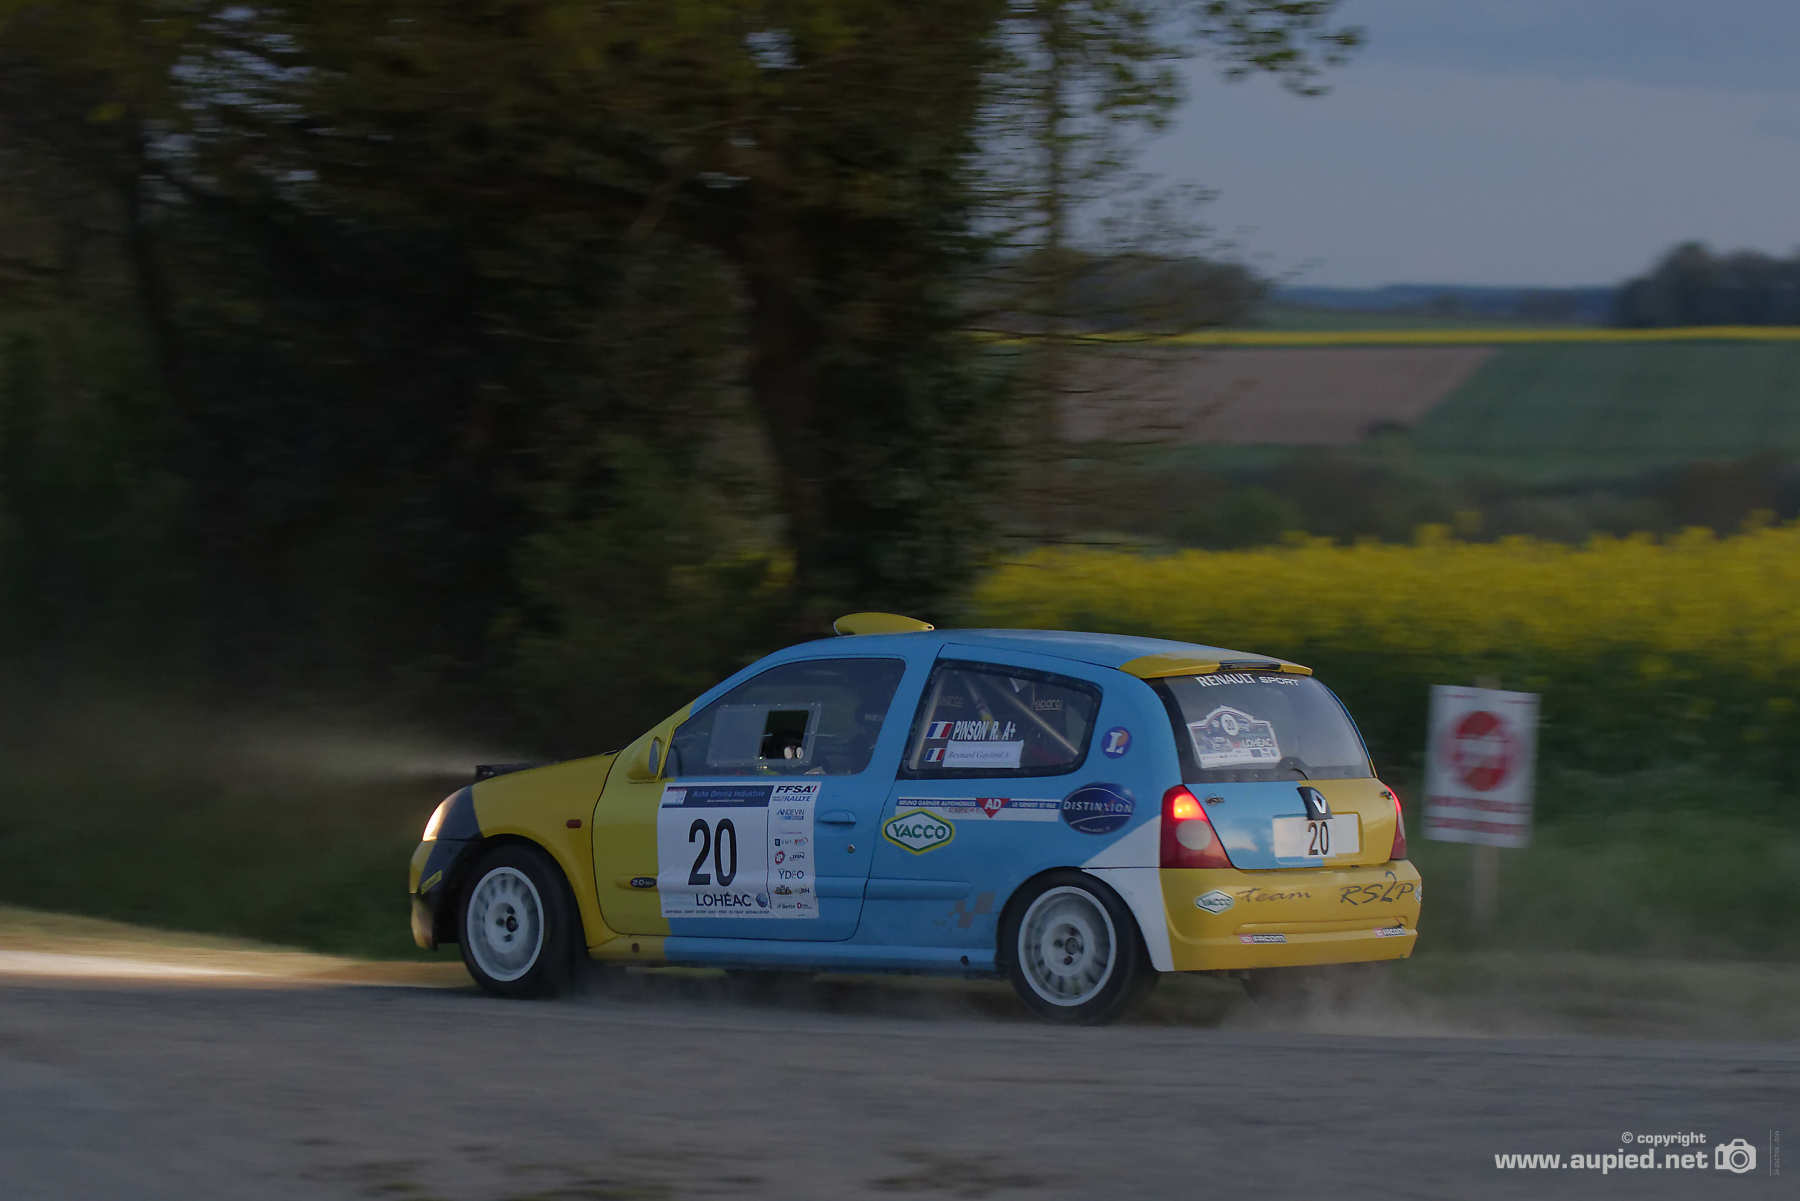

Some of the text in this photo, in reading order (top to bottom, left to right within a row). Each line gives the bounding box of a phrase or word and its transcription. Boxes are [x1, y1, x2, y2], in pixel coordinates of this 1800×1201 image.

[1195, 673, 1300, 687] RENAULT SPORT
[952, 720, 988, 741] PINSON
[776, 785, 813, 793] FFSA
[985, 799, 1002, 809] AD
[893, 824, 946, 839] YACCO
[1308, 821, 1329, 856] 20
[688, 818, 737, 887] 20
[696, 893, 752, 907] LOHÉAC
